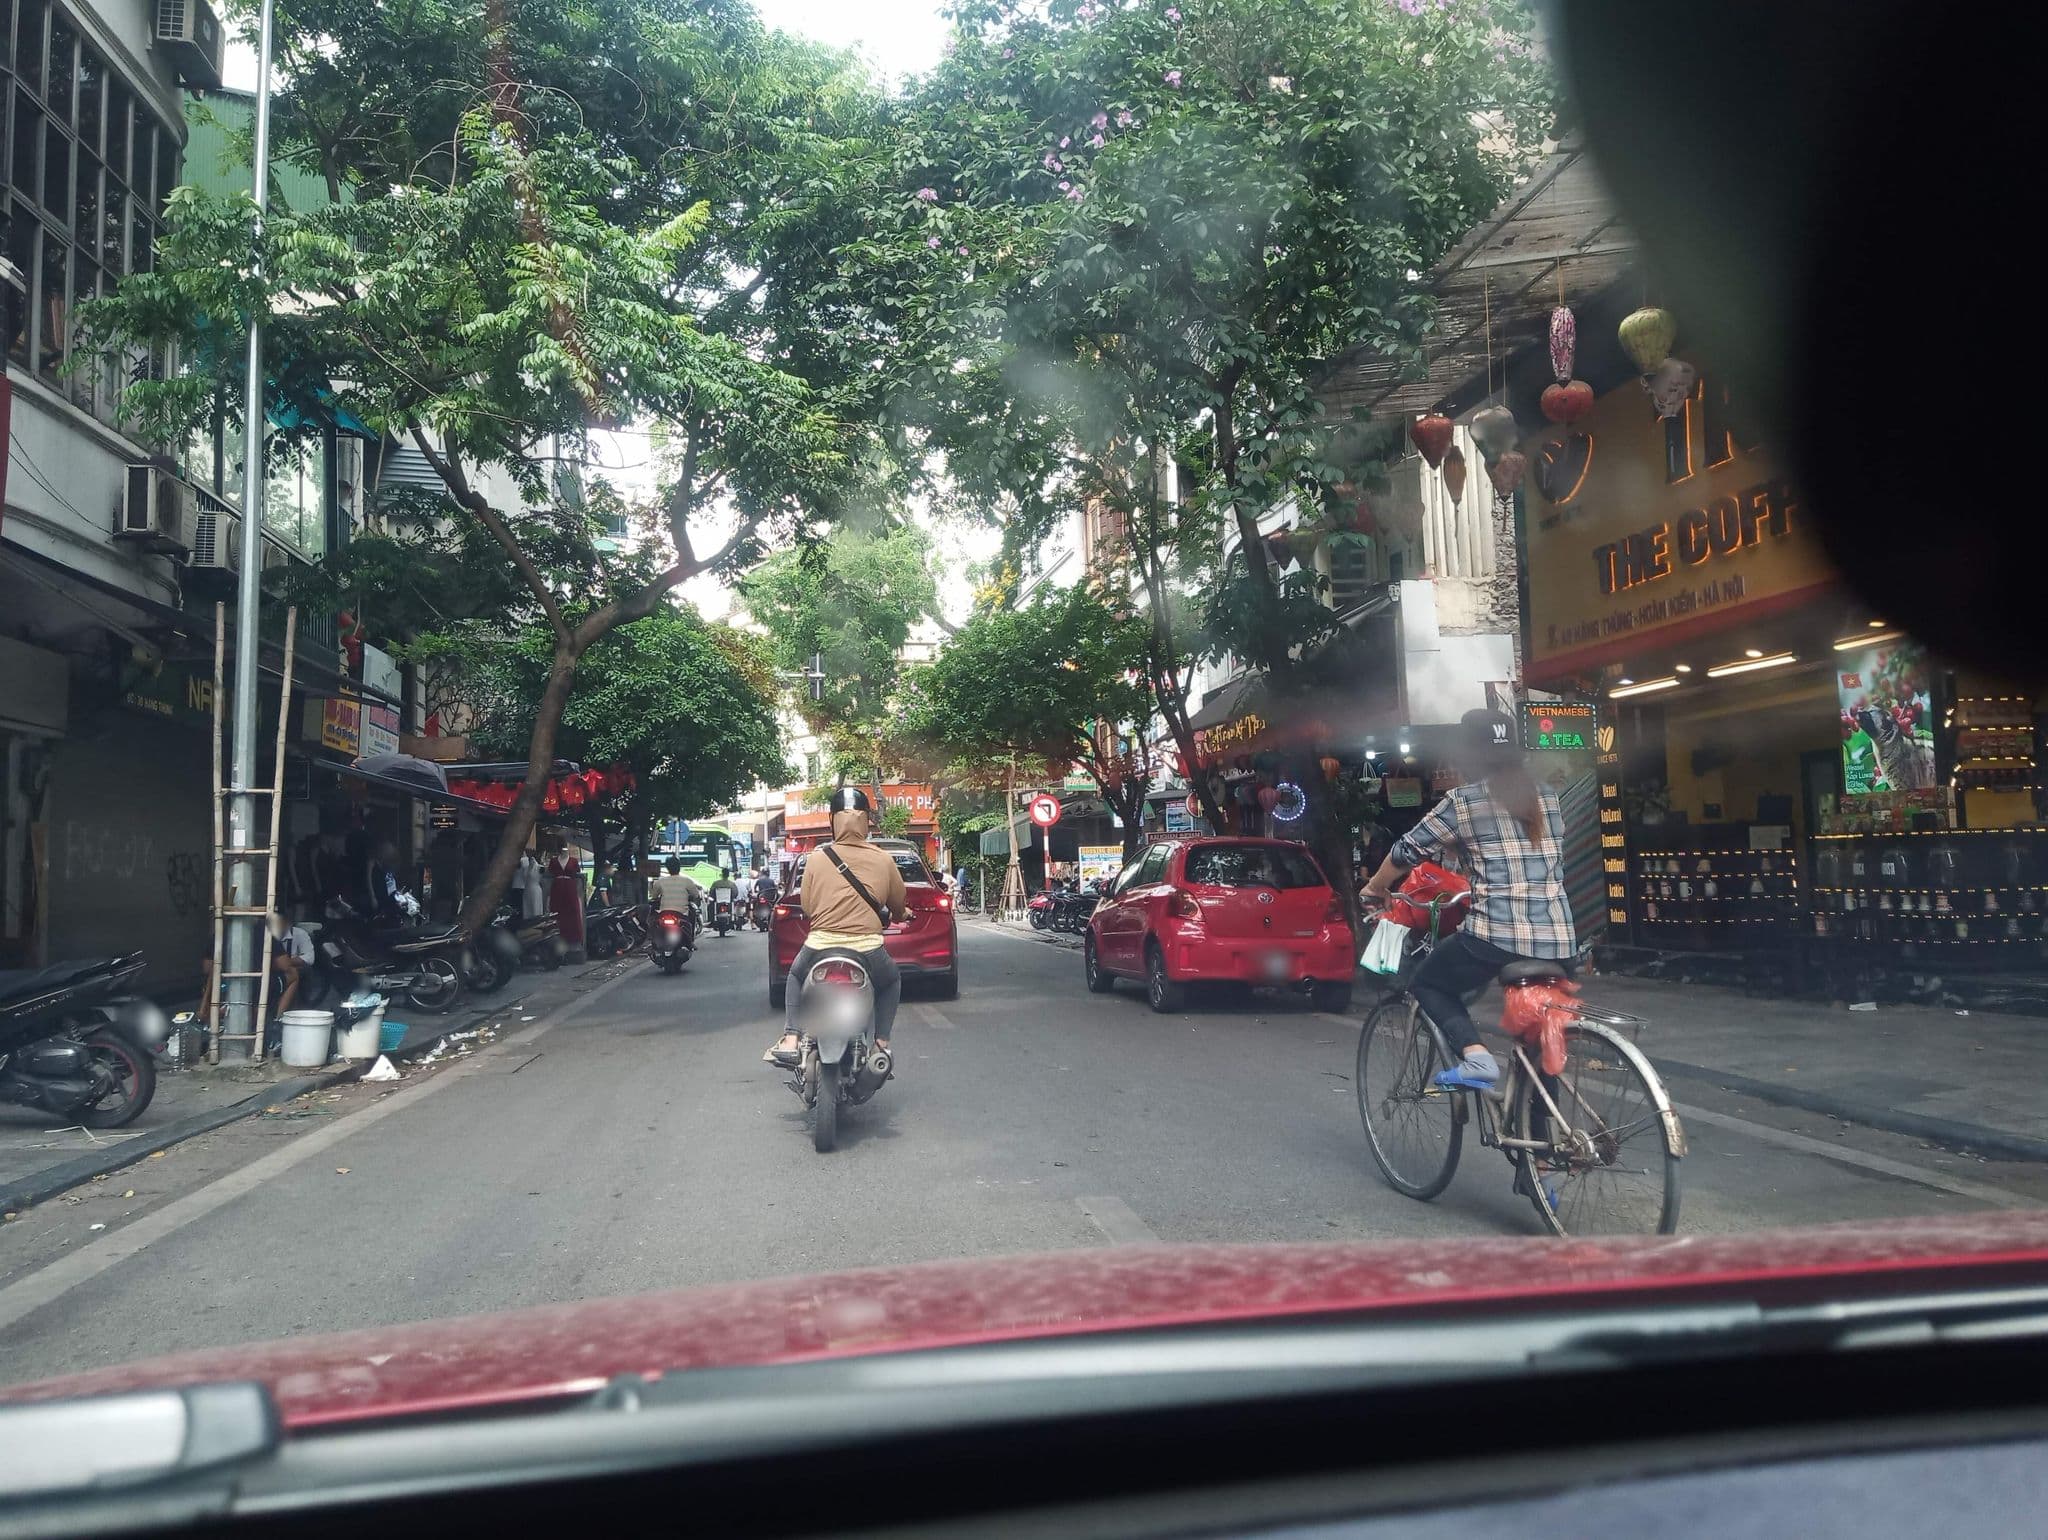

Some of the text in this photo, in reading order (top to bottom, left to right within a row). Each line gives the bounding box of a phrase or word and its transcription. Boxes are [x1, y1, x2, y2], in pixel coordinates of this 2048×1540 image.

[1593, 522, 1673, 595] THE
[1529, 707, 1590, 717] VIETNAMESE
[1492, 723, 1507, 738] W
[1539, 733, 1583, 746] & TEA
